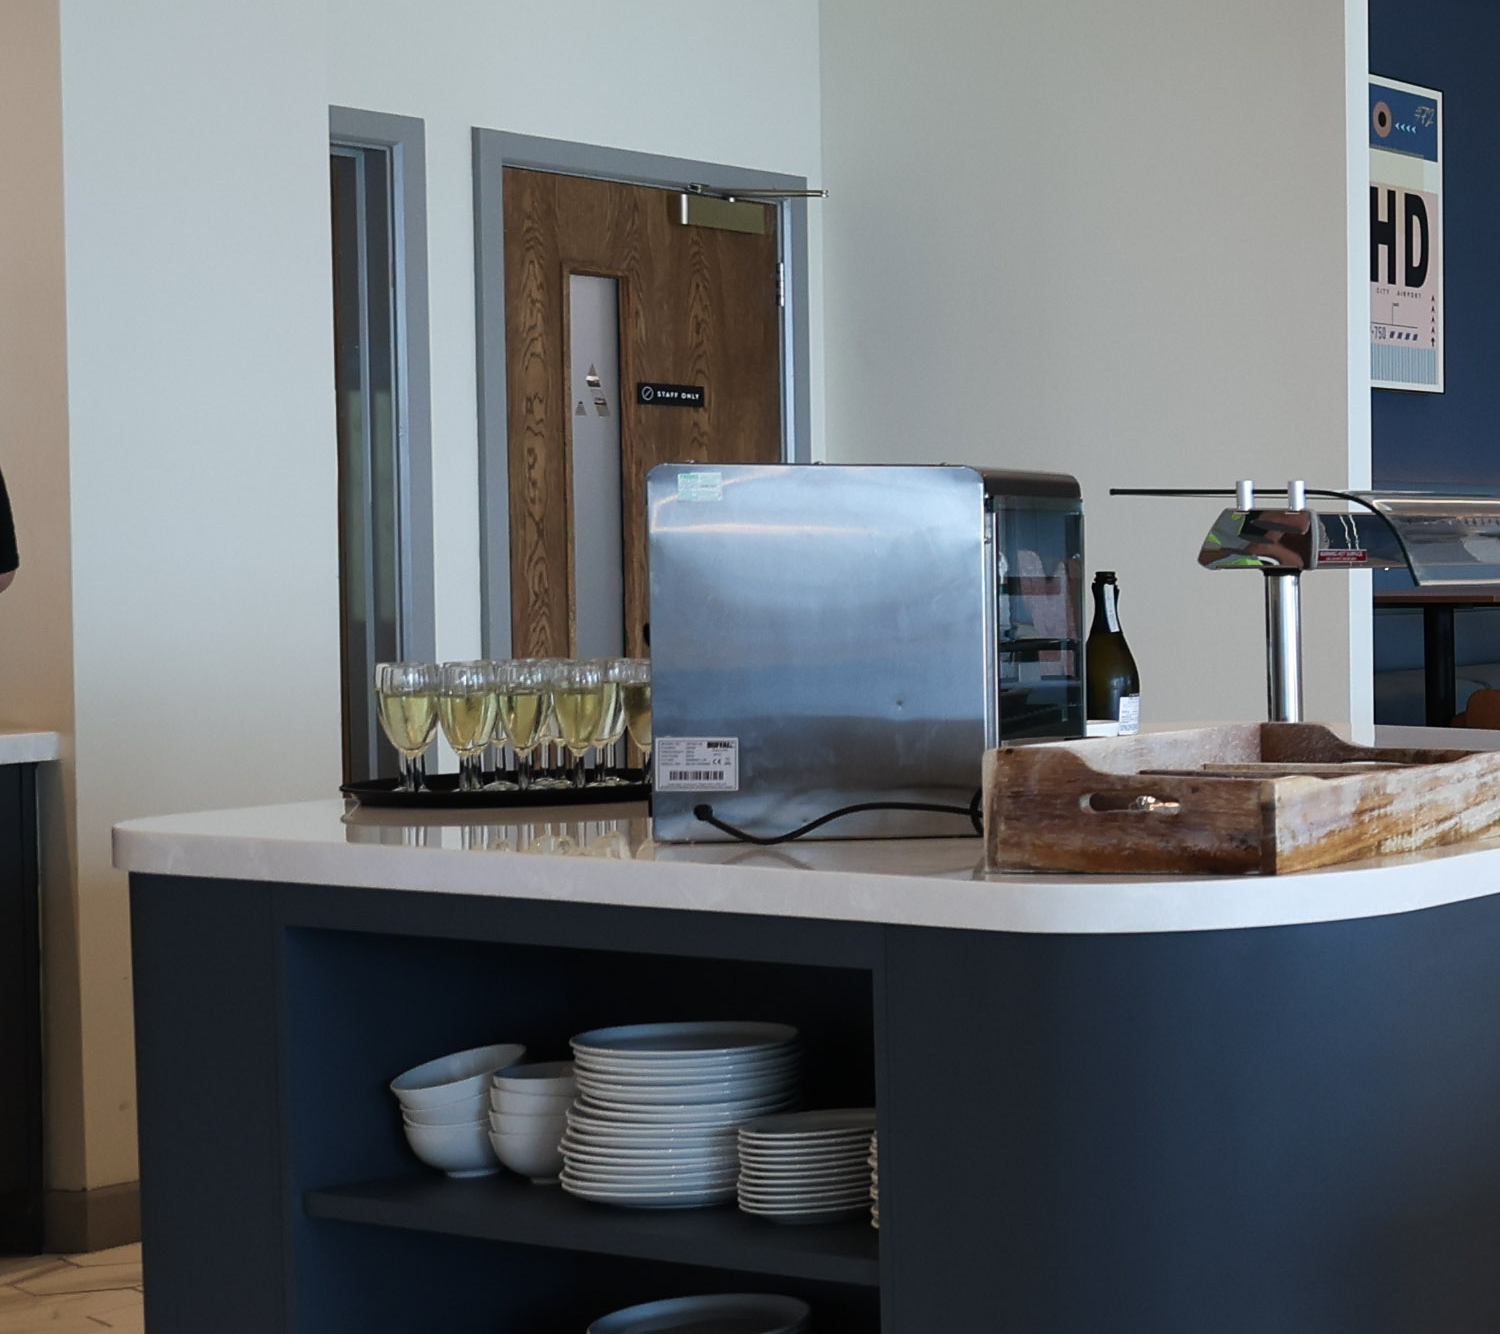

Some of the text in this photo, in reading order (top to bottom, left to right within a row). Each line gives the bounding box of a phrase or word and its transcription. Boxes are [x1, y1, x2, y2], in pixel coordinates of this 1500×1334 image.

[1397, 290, 1422, 299] AIRPORT
[657, 390, 700, 401] STAFF ONLY
